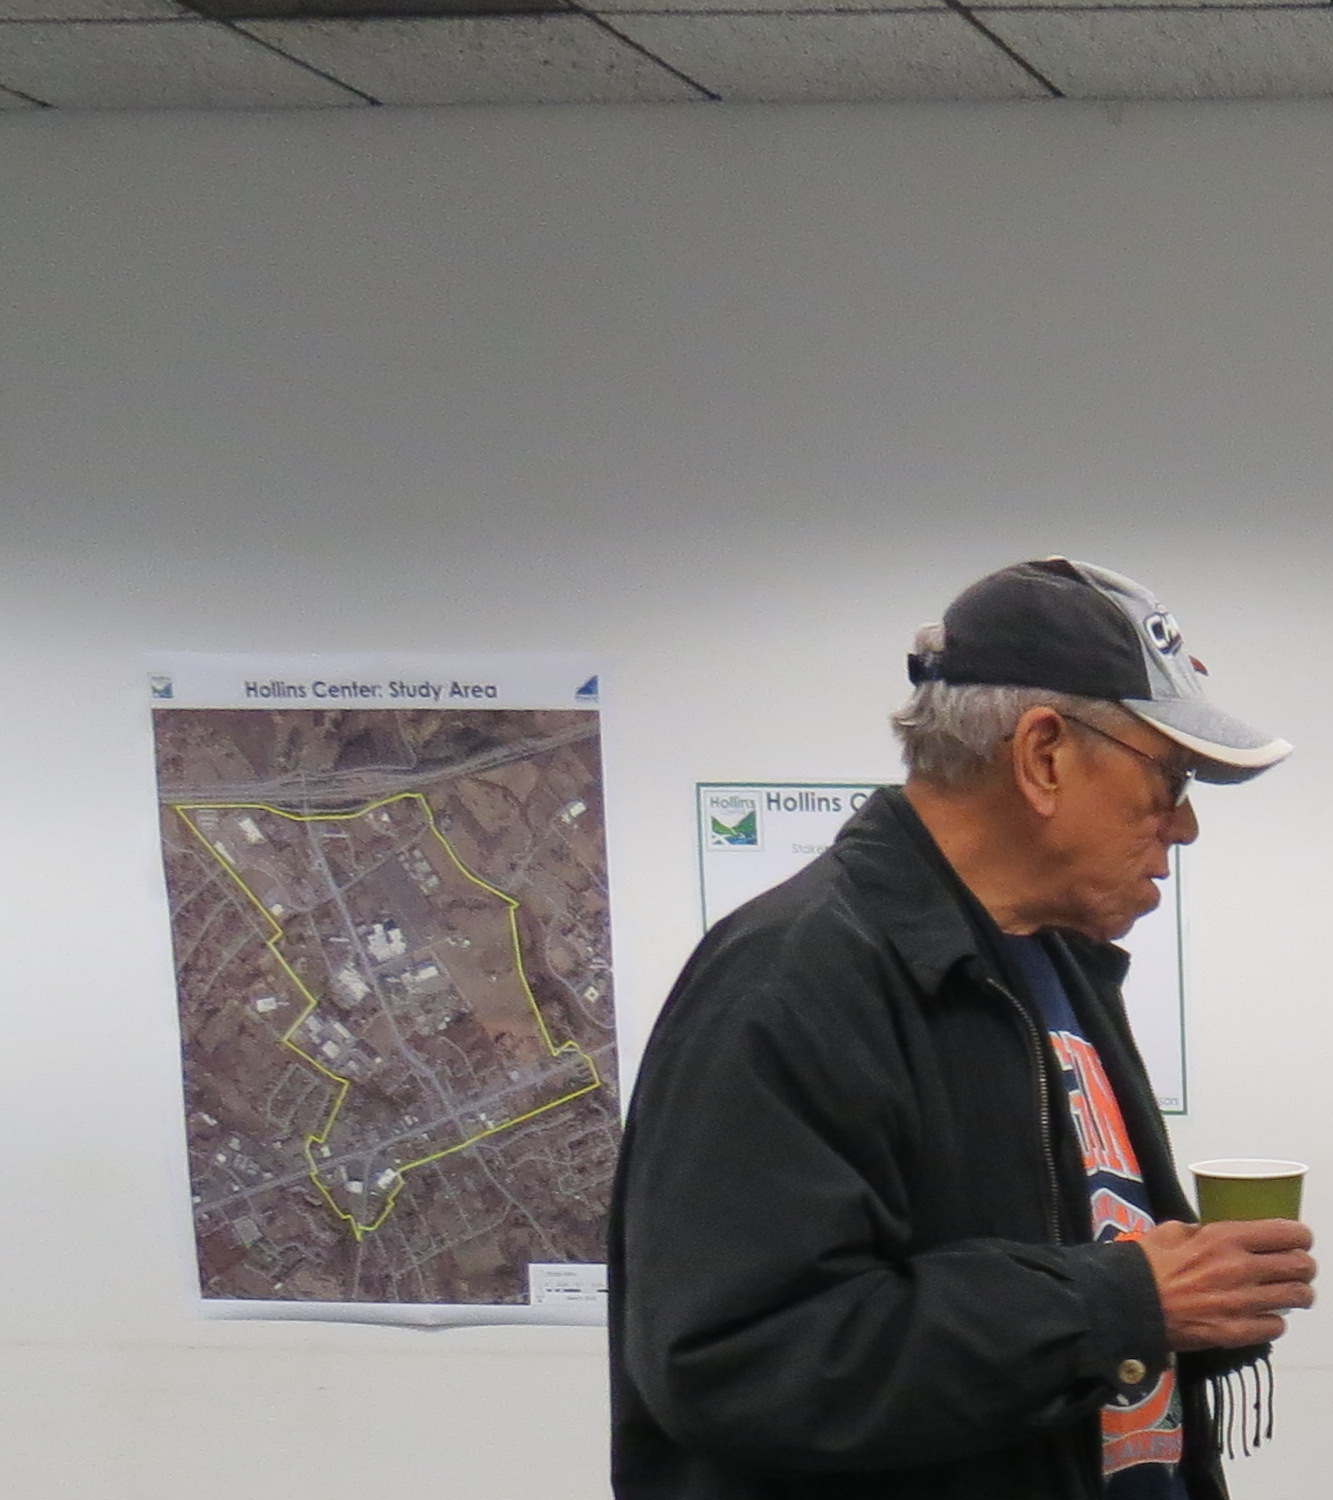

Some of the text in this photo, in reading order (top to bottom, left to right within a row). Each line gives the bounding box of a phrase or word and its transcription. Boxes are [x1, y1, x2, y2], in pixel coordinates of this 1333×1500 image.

[245, 681, 498, 702] Hollins Center: Study Area
[709, 796, 756, 809] Hollins
[766, 791, 843, 813] Hollins
